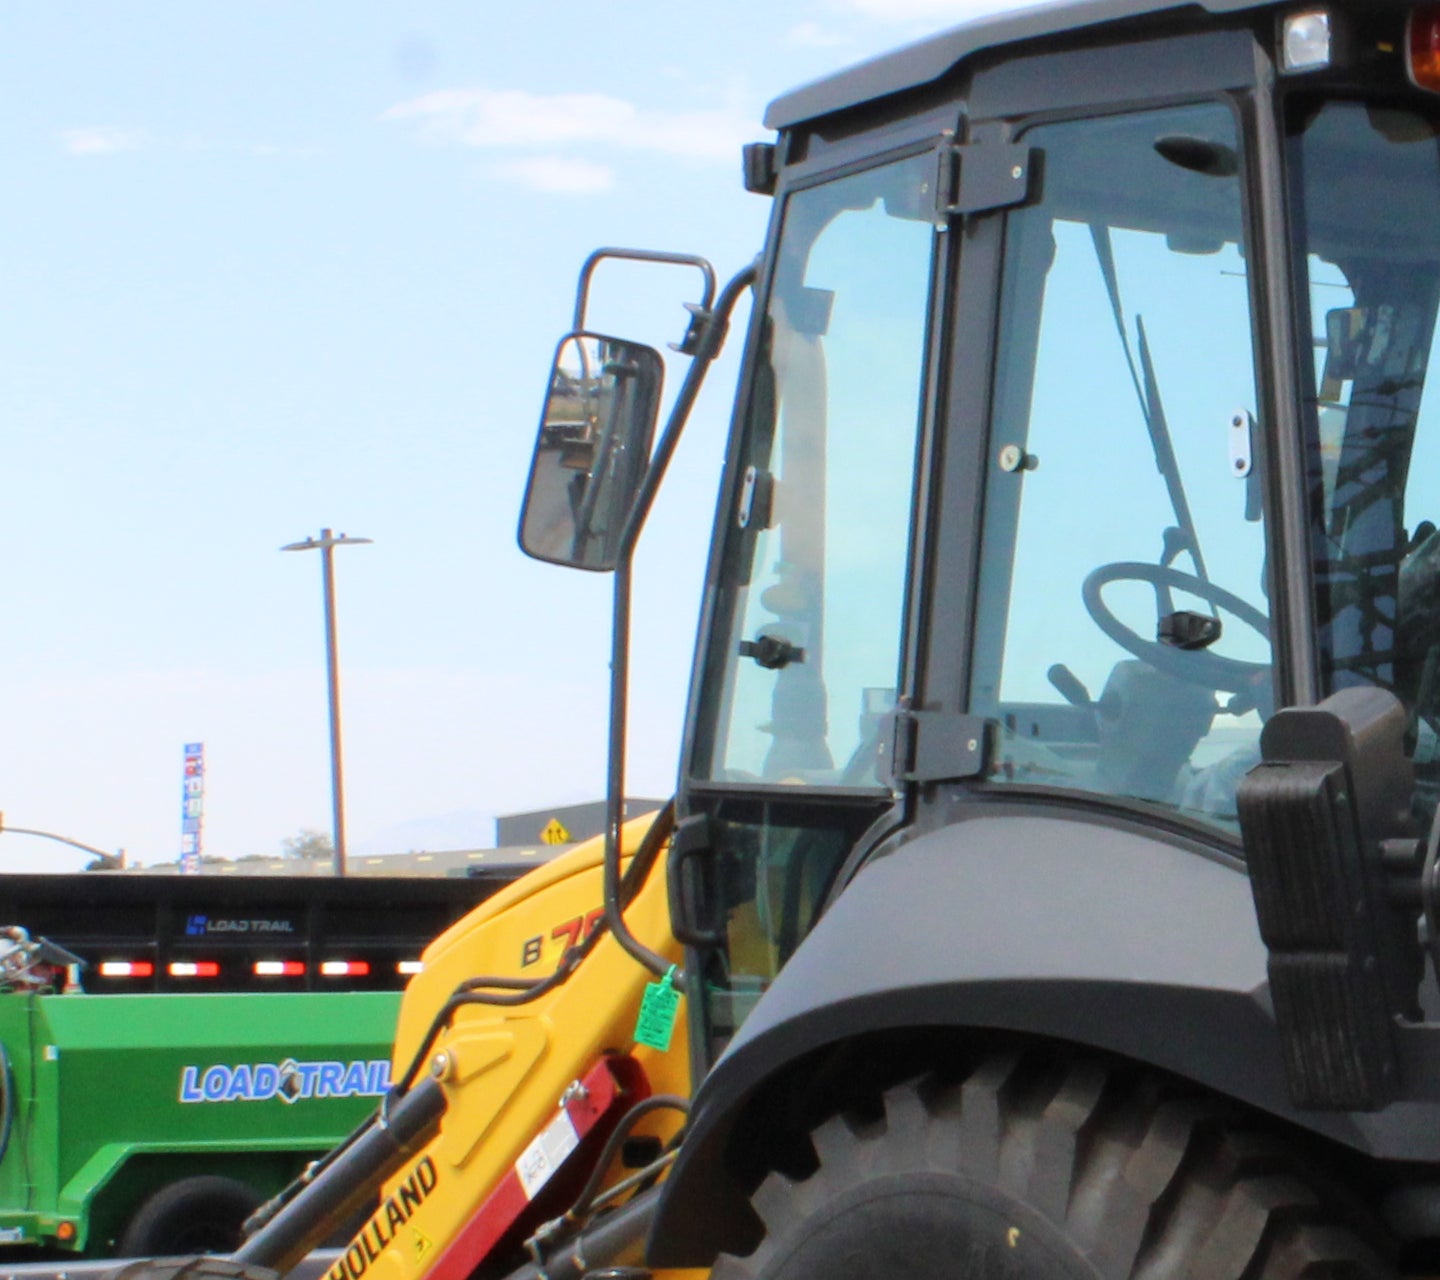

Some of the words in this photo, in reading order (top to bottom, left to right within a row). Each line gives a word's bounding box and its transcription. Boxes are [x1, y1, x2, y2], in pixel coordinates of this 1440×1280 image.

[206, 921, 249, 933] LOAD
[250, 920, 295, 932] TRAIL
[179, 1064, 279, 1103] LOAD
[292, 1059, 393, 1099] TRAIL
